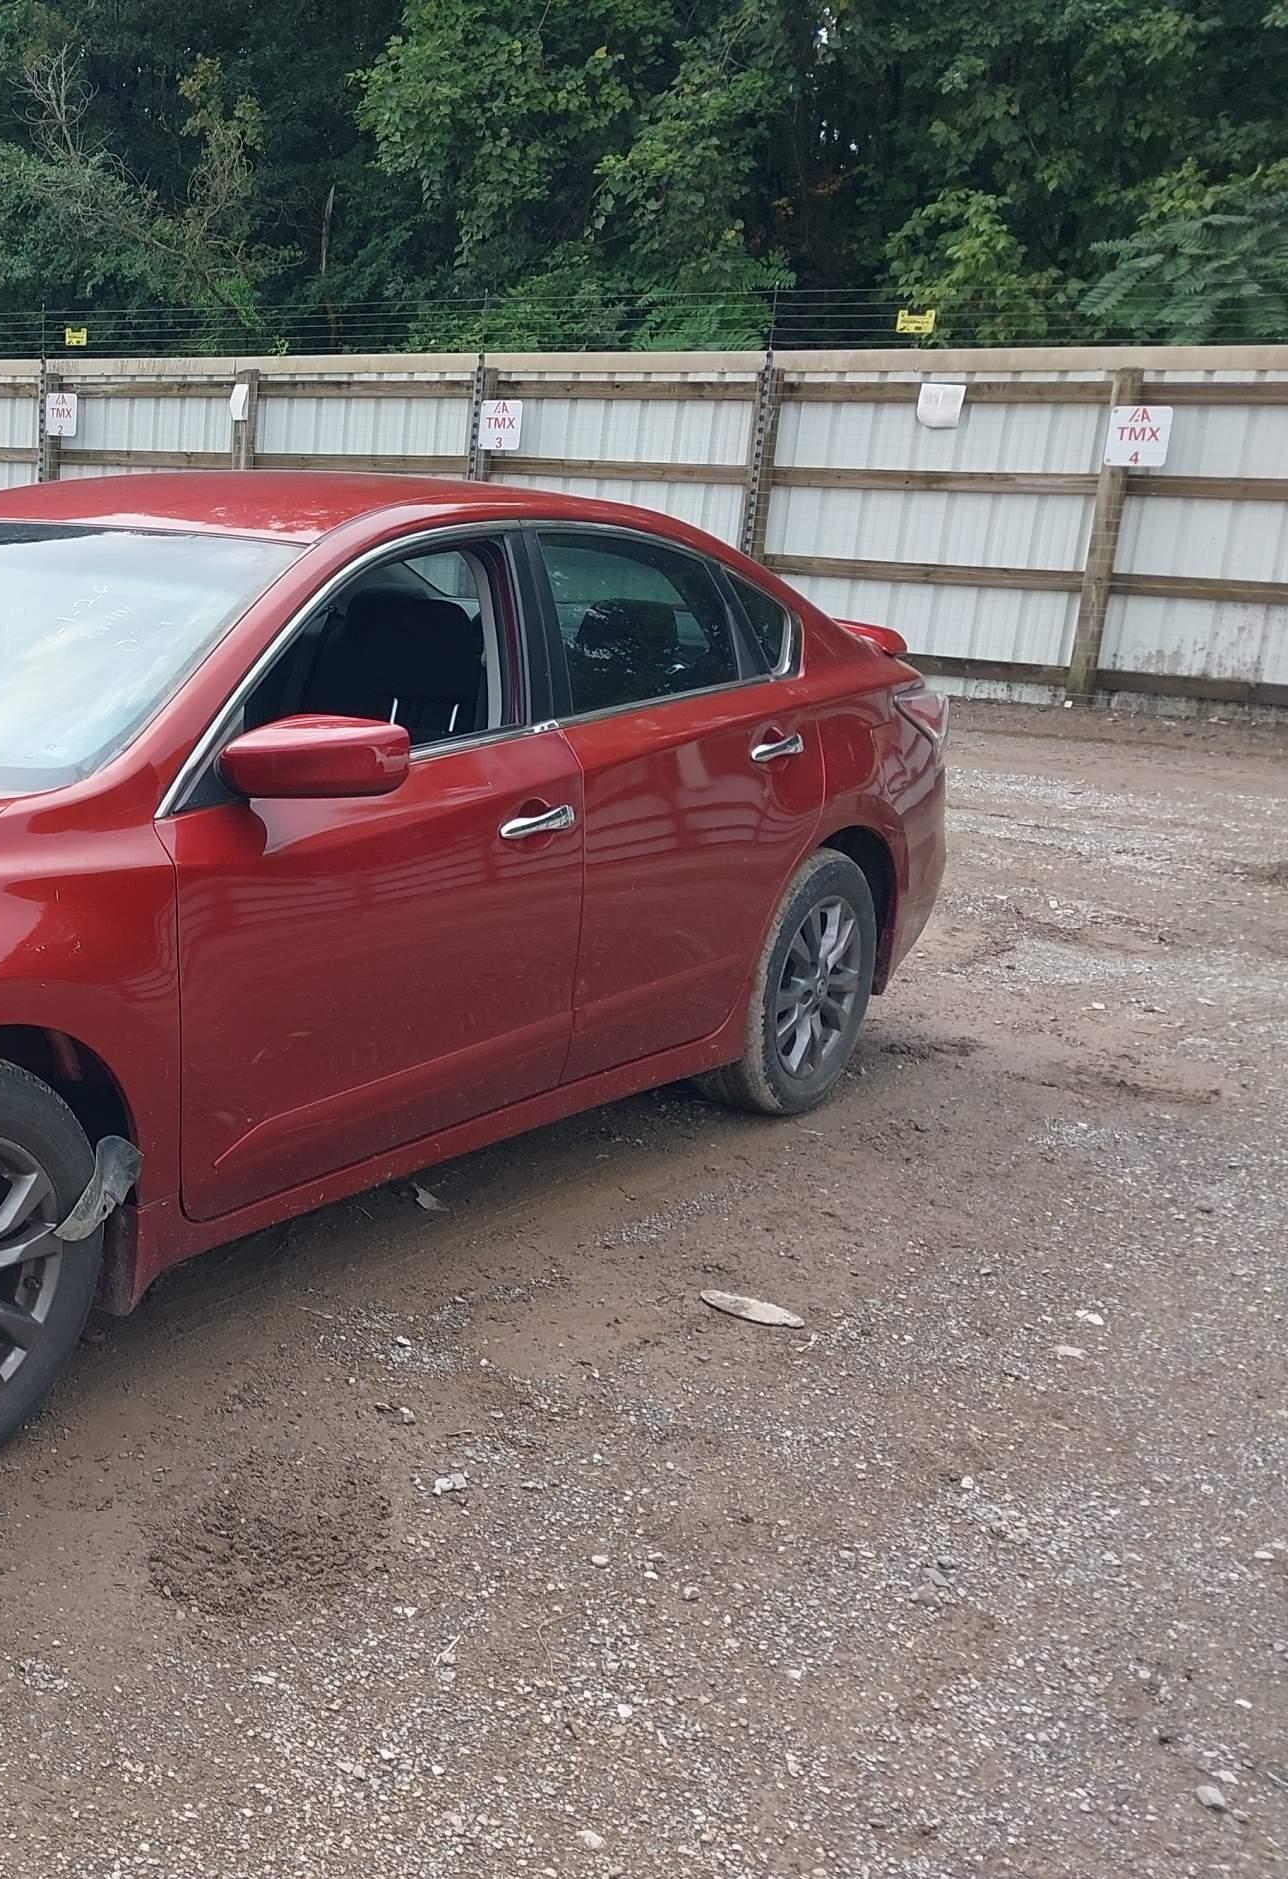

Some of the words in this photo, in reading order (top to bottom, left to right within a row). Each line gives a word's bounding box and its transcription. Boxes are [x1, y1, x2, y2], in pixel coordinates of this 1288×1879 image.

[49, 407, 72, 418] TMX
[486, 416, 515, 429] TMX
[58, 425, 64, 434] 2
[1117, 426, 1161, 442] TMX
[495, 436, 503, 448] 3
[1128, 451, 1140, 465] 4
